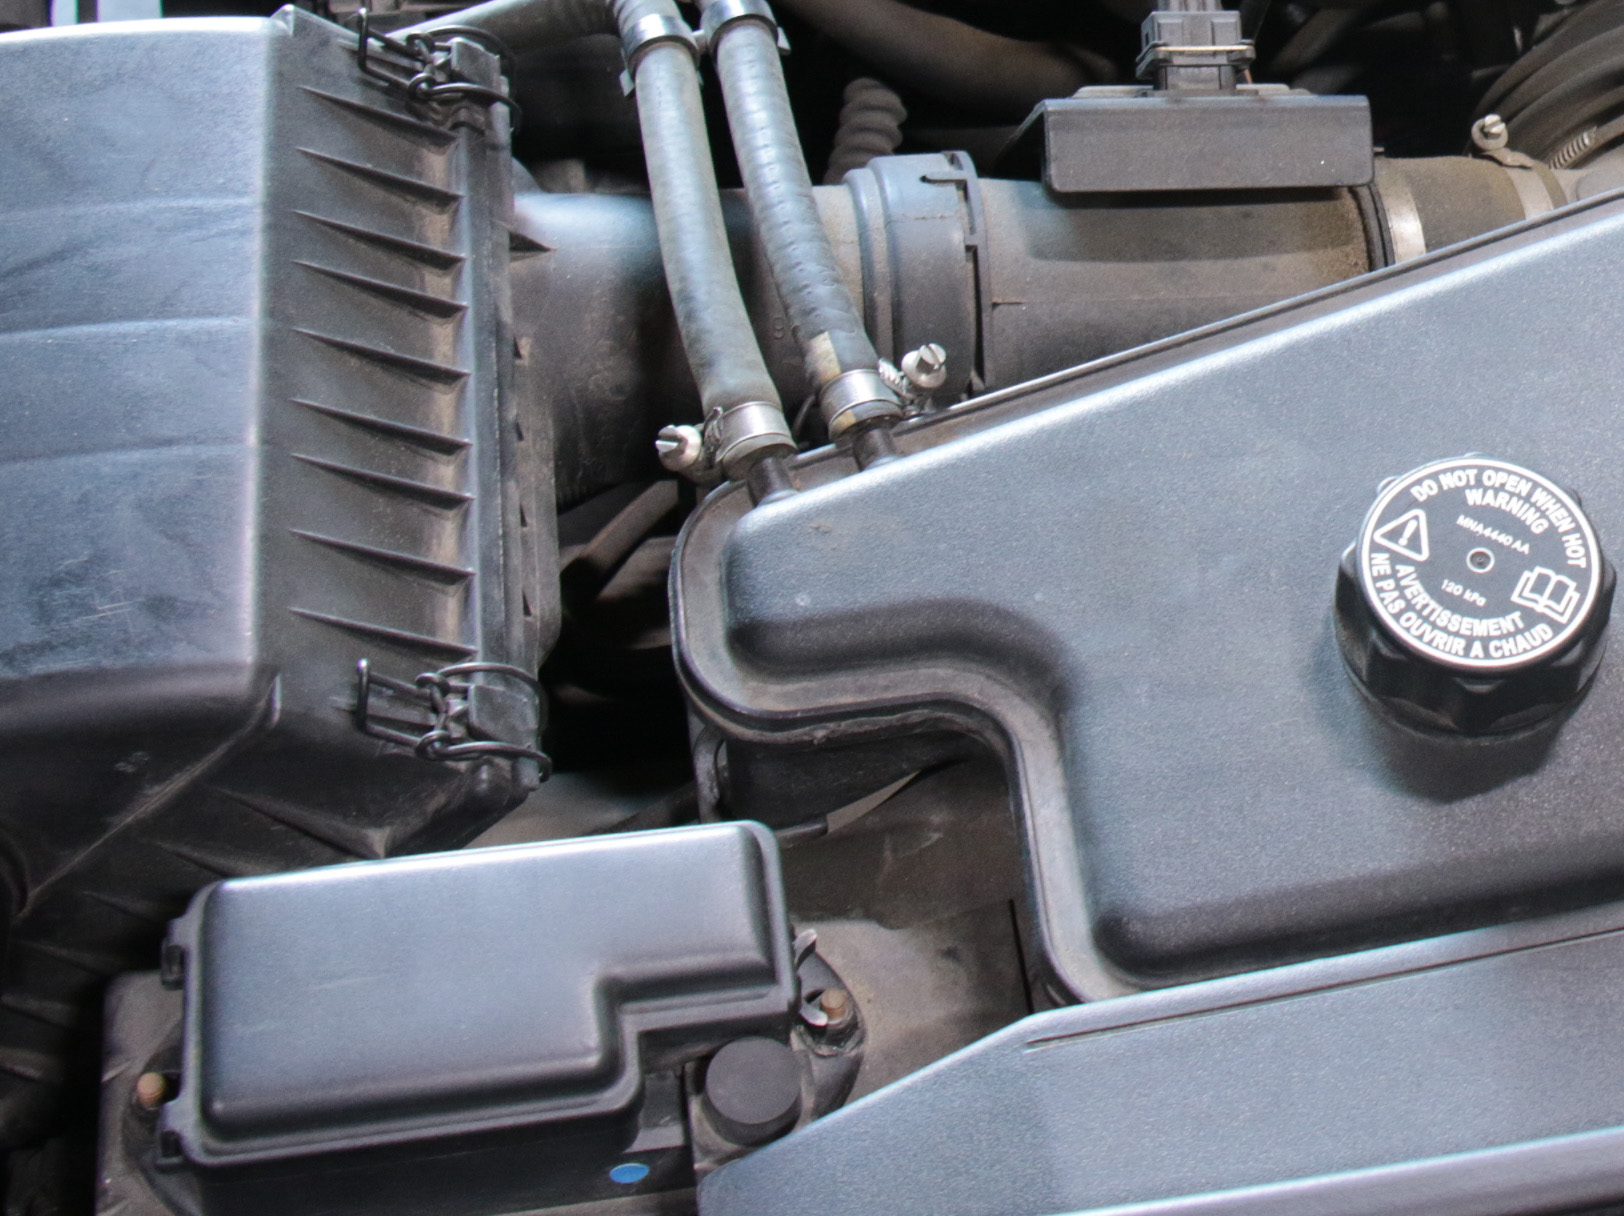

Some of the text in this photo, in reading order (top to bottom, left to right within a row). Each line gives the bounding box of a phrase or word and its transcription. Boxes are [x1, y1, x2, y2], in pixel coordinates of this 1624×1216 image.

[1410, 469, 1587, 568] DO NOT OPEN WHEN HOT
[1465, 488, 1550, 535] WARNING
[1371, 552, 1554, 658] NE PAS OUVRIR A CHAUD
[1395, 564, 1525, 637] AVERTISSEMENT
[1441, 578, 1487, 607] 120 kPa
